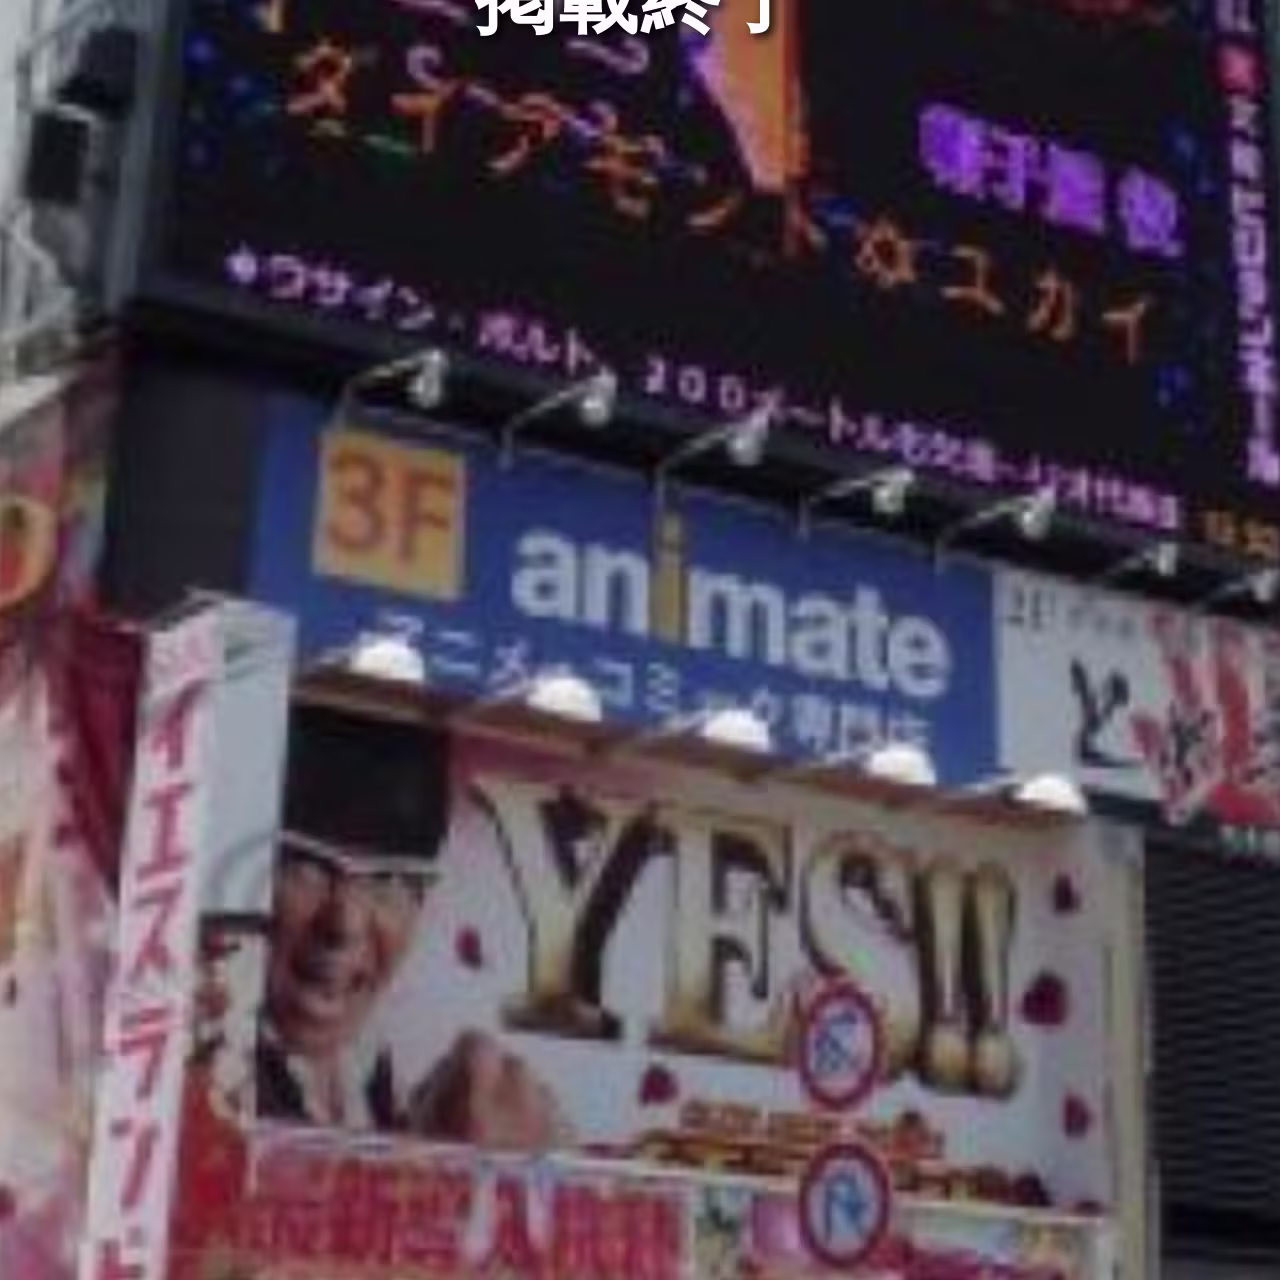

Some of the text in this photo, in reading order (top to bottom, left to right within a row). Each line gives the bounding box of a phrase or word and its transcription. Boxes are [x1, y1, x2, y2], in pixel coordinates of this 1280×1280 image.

[328, 444, 458, 566] 3F
[510, 512, 954, 700] animate
[472, 776, 1020, 1100] YES!!
